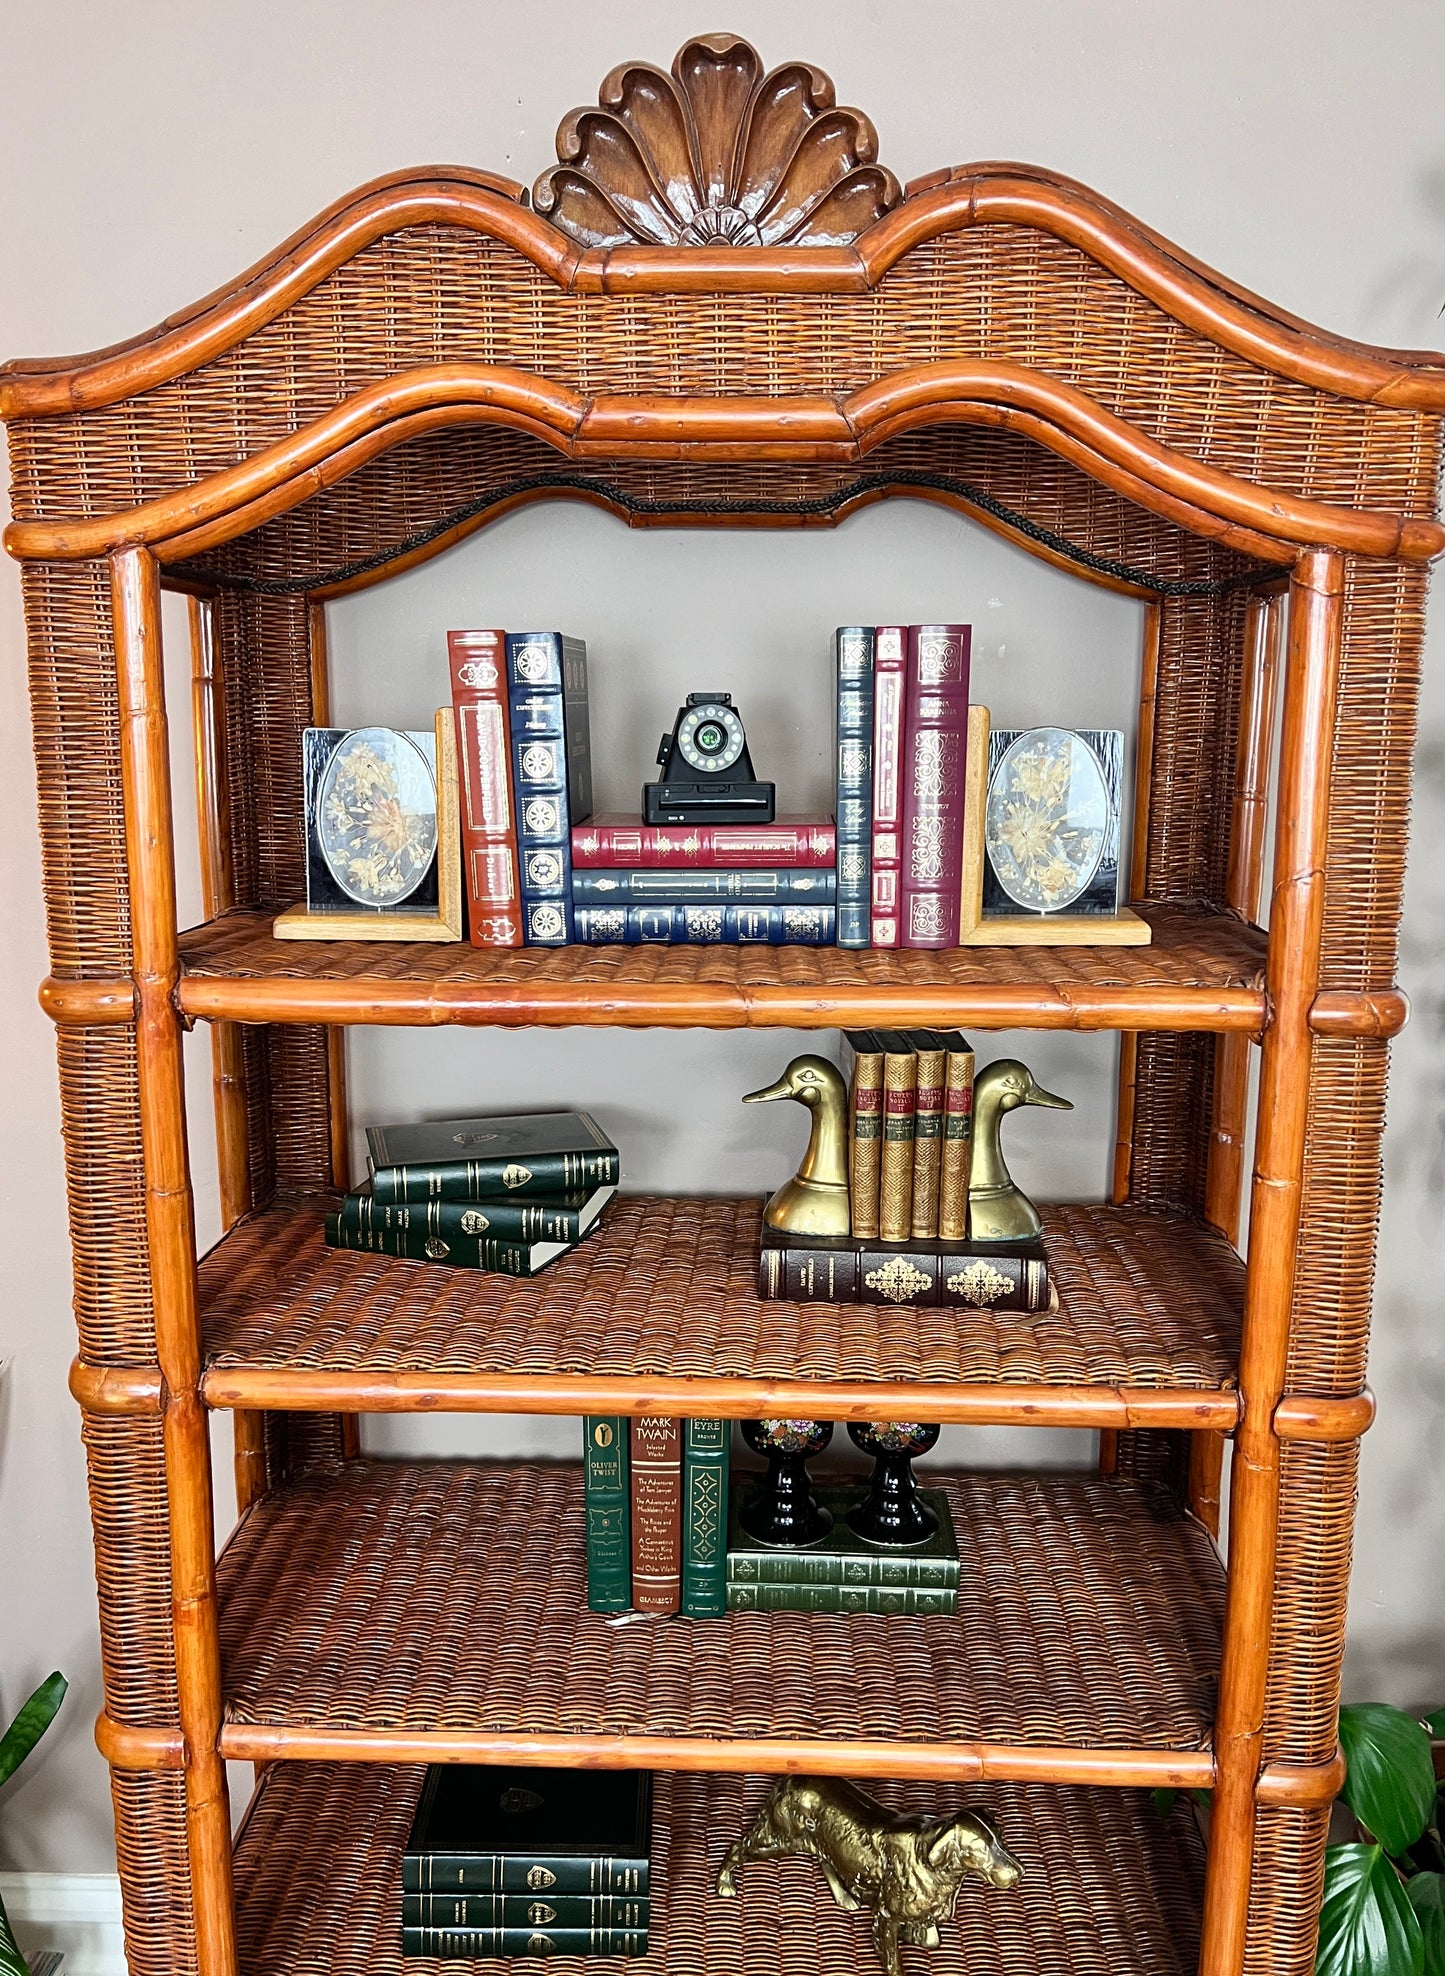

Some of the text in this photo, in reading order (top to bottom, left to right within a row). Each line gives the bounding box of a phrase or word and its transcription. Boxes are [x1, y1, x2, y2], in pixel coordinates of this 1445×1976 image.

[476, 714, 492, 821] DAVID COPPERFIELD
[640, 1418, 671, 1427] MARK
[694, 1422, 720, 1430] EYRE
[636, 1428, 676, 1440] TWAIN
